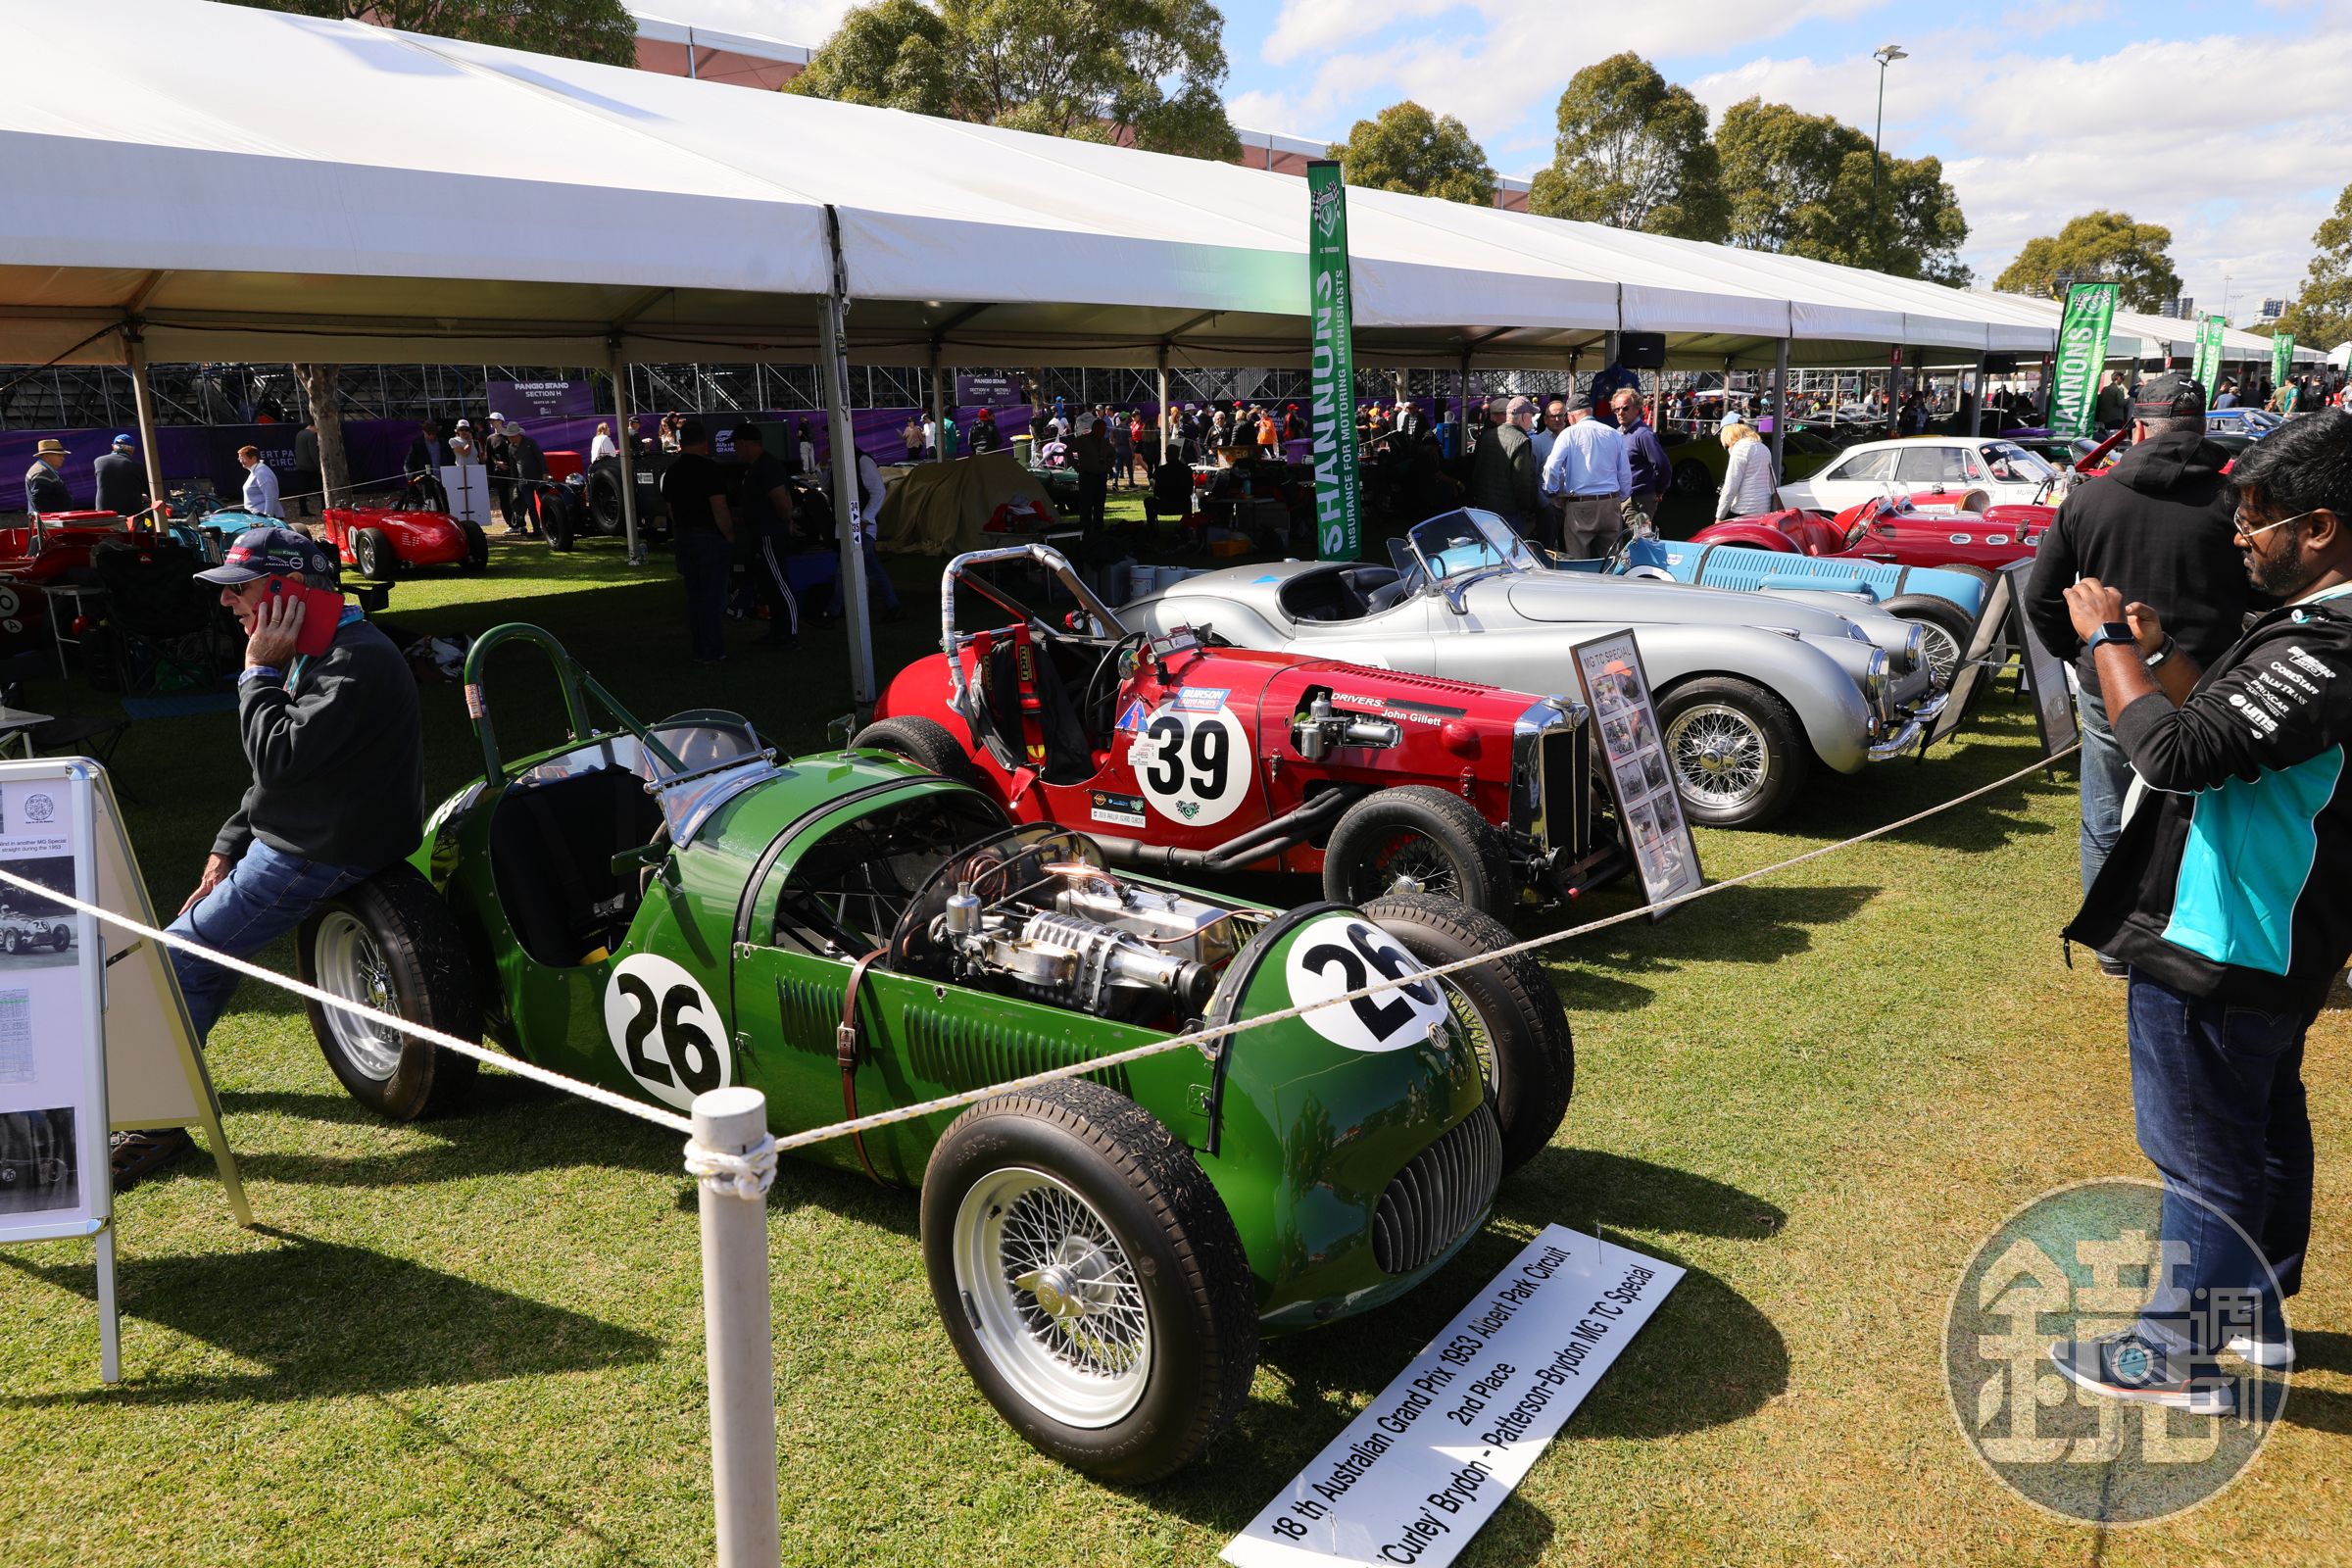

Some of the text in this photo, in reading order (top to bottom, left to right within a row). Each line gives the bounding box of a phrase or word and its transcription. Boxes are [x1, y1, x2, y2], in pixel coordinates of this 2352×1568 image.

[2053, 327, 2093, 438] HANNONS
[1335, 270, 1357, 549] INSURANCE FOR MOTORING ENTHUSIASTS
[851, 502, 858, 511] 34
[853, 523, 859, 532] 35
[1584, 646, 1631, 668] MG TC SPECIAL
[2293, 658, 2318, 674] AUTO
[1182, 689, 1225, 699] BURSON
[1331, 692, 1386, 708] DRIVERS:
[2250, 680, 2289, 713] PRIXCAR
[2258, 672, 2308, 706] PALM TRANS
[1381, 709, 1442, 726] John Gillett
[1148, 716, 1229, 800] 39
[1302, 923, 1439, 1043] 26
[616, 972, 721, 1097] 26
[1613, 1264, 1657, 1306] Special
[1589, 1300, 1623, 1325] TC
[1574, 1318, 1609, 1350] MG
[1271, 1245, 1572, 1542] 18 th Australian Grand Prix 1953 Albert Park Circuit
[1446, 1361, 1517, 1427] 2nd Place
[1482, 1342, 1592, 1451] Patterson-Brydon
[1426, 1460, 1494, 1515] Brydon
